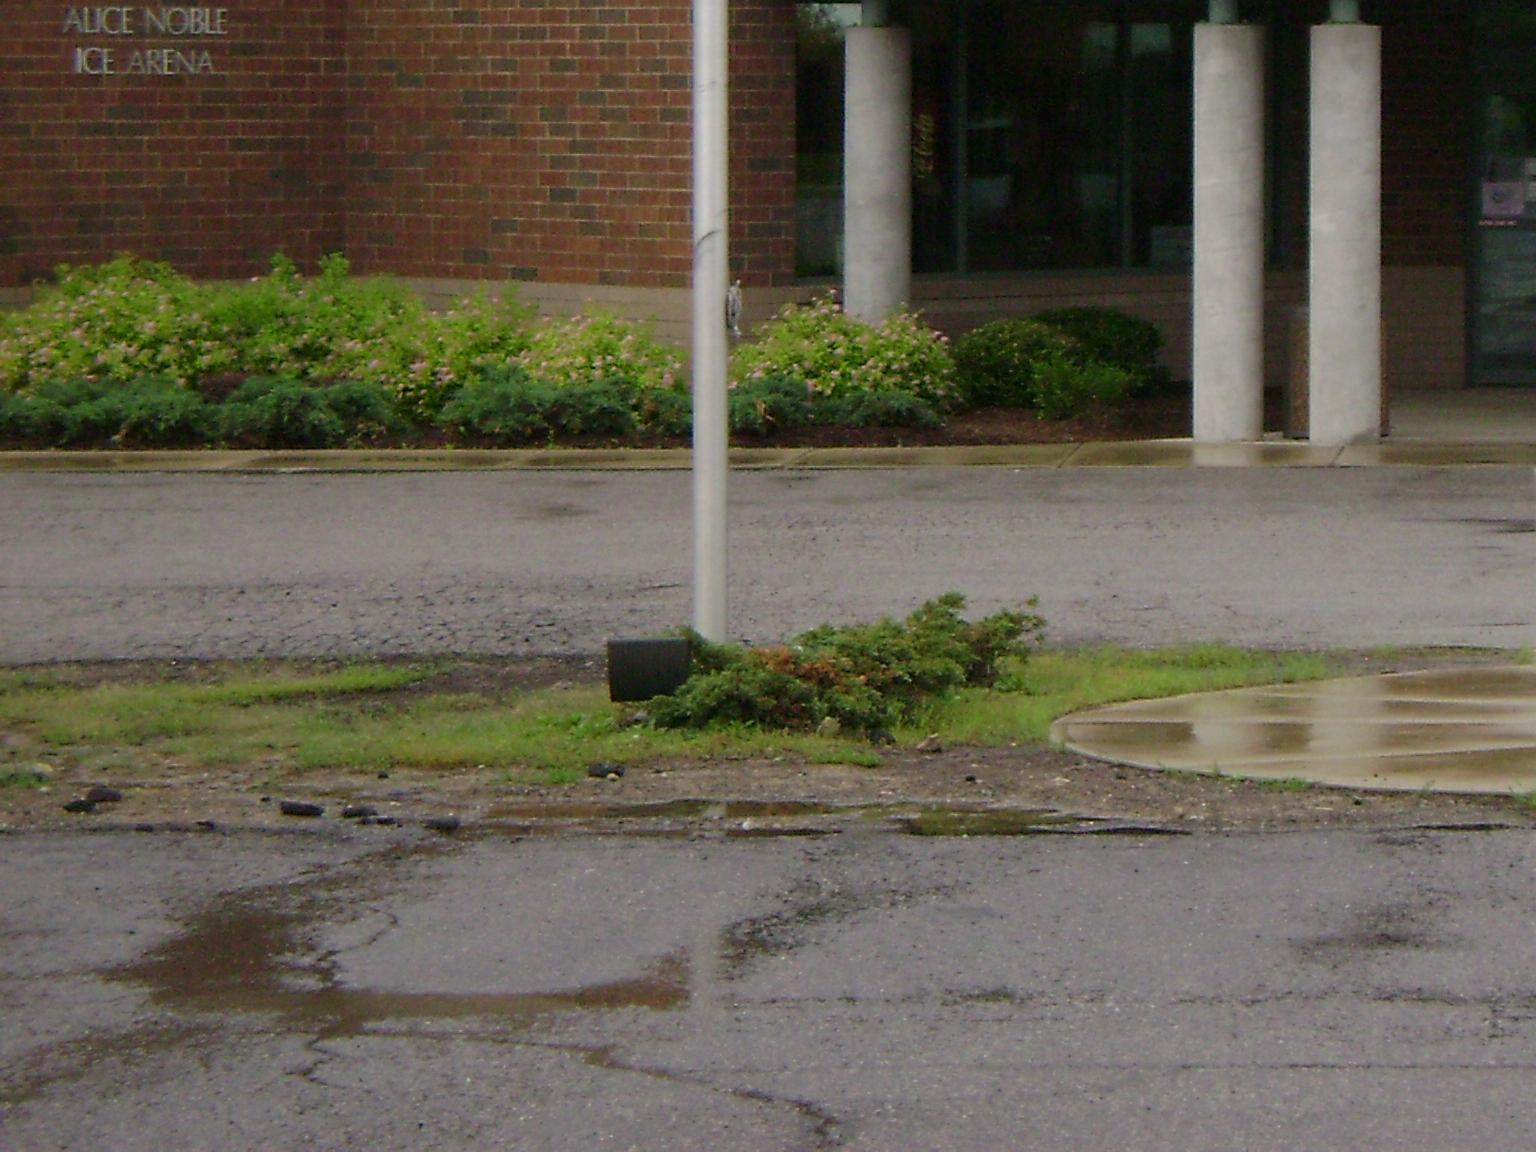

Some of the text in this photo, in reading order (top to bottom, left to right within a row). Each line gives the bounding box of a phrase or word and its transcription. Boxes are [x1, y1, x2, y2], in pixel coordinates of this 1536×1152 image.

[62, 7, 229, 36] ALICE NOBLE
[74, 47, 215, 76] ICE ARENA
